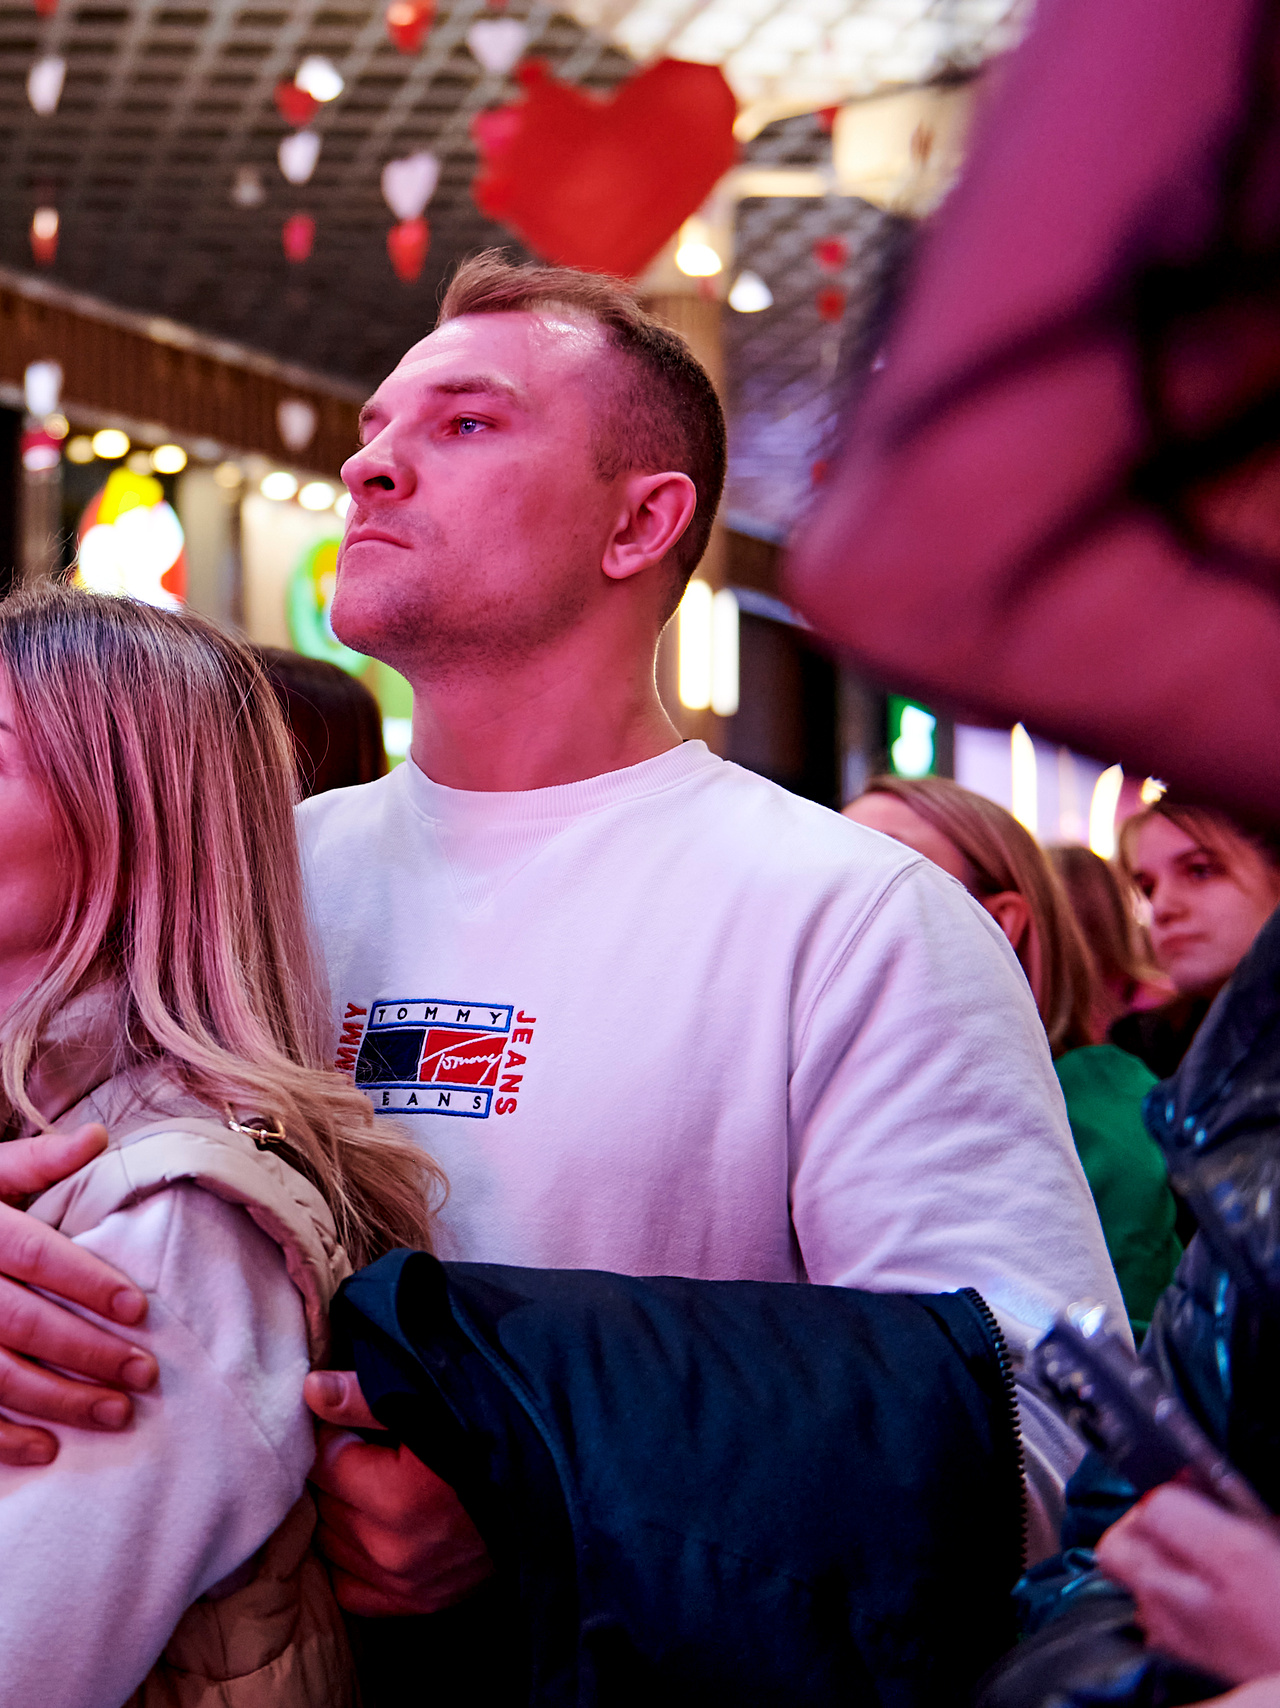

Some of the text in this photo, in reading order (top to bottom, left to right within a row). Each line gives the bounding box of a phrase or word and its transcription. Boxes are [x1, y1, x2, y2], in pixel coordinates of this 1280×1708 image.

[333, 1002, 368, 1076] MMY
[378, 1006, 503, 1025] TOMMY
[494, 1009, 537, 1116] JEANS
[363, 1090, 483, 1111] EANS
